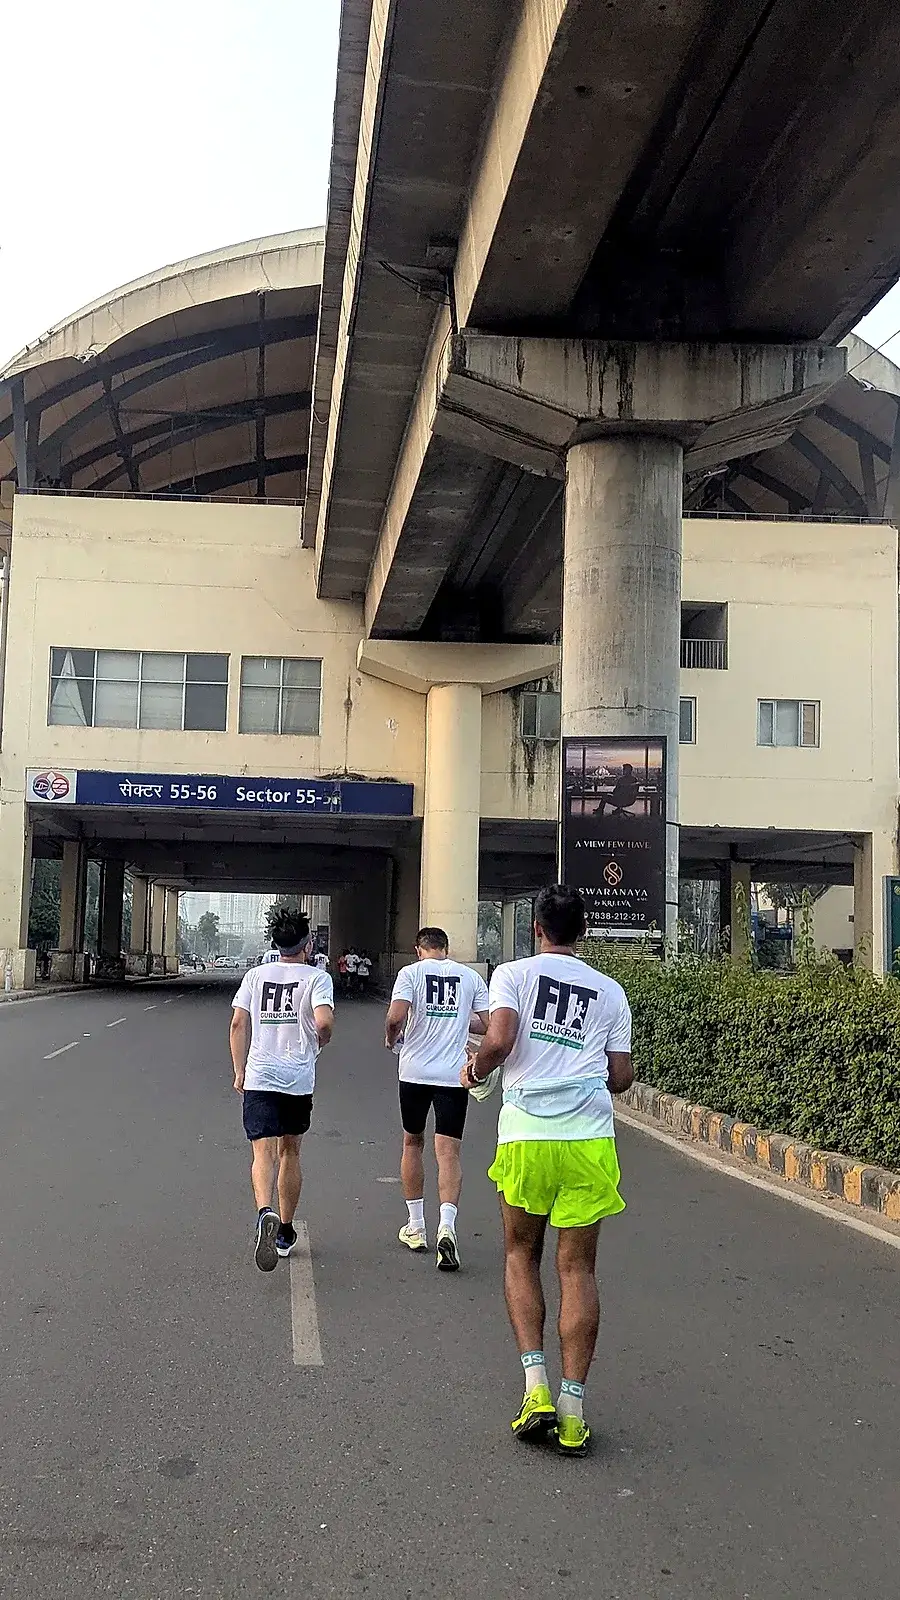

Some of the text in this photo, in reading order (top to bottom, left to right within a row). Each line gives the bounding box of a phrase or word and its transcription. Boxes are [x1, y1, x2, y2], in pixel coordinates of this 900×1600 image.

[119, 779, 217, 800] सेक्टर 55-56
[236, 786, 291, 803] Sector
[583, 840, 605, 848] VIEW
[607, 841, 625, 849] FEW
[578, 887, 648, 897] SWARANAYA
[589, 911, 646, 921] 7838-212-212
[260, 981, 300, 1012] FIT
[425, 974, 461, 1005] FIT
[532, 974, 598, 1031] FIT
[531, 1021, 586, 1042] GURUGRAM
